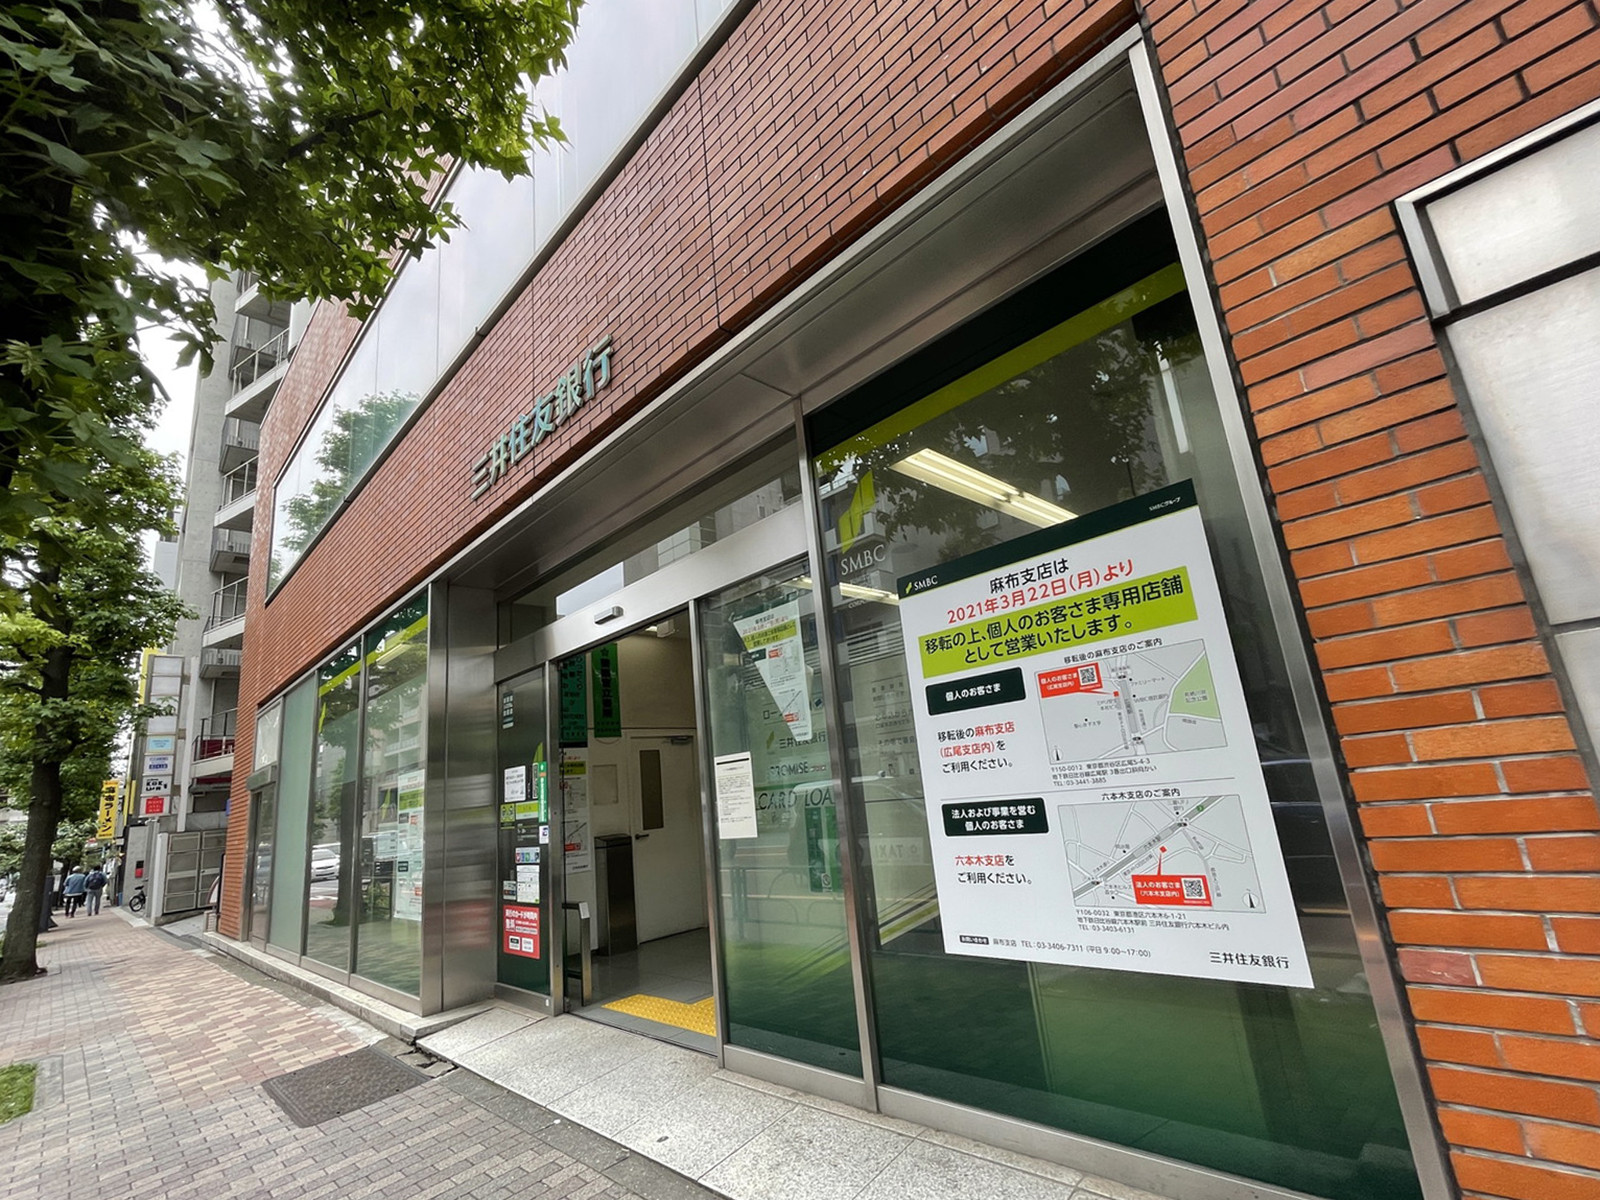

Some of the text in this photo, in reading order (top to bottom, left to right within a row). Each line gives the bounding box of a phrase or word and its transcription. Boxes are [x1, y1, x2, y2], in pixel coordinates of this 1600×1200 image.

[471, 334, 613, 500] 三井住友銀行
[1148, 497, 1181, 511] SMBCグループ
[840, 543, 886, 576] SMBC
[914, 575, 938, 590] SMBC
[989, 558, 1070, 594] 麻布支店は
[947, 559, 1133, 624] 2021年3月22日(月)より
[925, 575, 1184, 654] 移転の上、個人のお客さま専用店舗
[964, 614, 1132, 664] として営業いたします。
[1064, 637, 1162, 664] 移転後の麻布支店のご案内
[945, 683, 1001, 701] 個人のお客さま
[938, 721, 1015, 742] 移転後の麻布支店
[943, 758, 1012, 774] ご利用ください。
[804, 788, 835, 807] LOA
[1100, 787, 1181, 801] 六本木支店のご案内
[950, 803, 1036, 820] 法人および事業を営む
[964, 818, 1024, 831] 個人のお客さま
[954, 854, 1015, 867] 六本木支店を
[958, 871, 1031, 884] ご利用ください。
[1134, 880, 1181, 888] 法人のお客さま
[1210, 951, 1289, 969] 三井住友銀行
